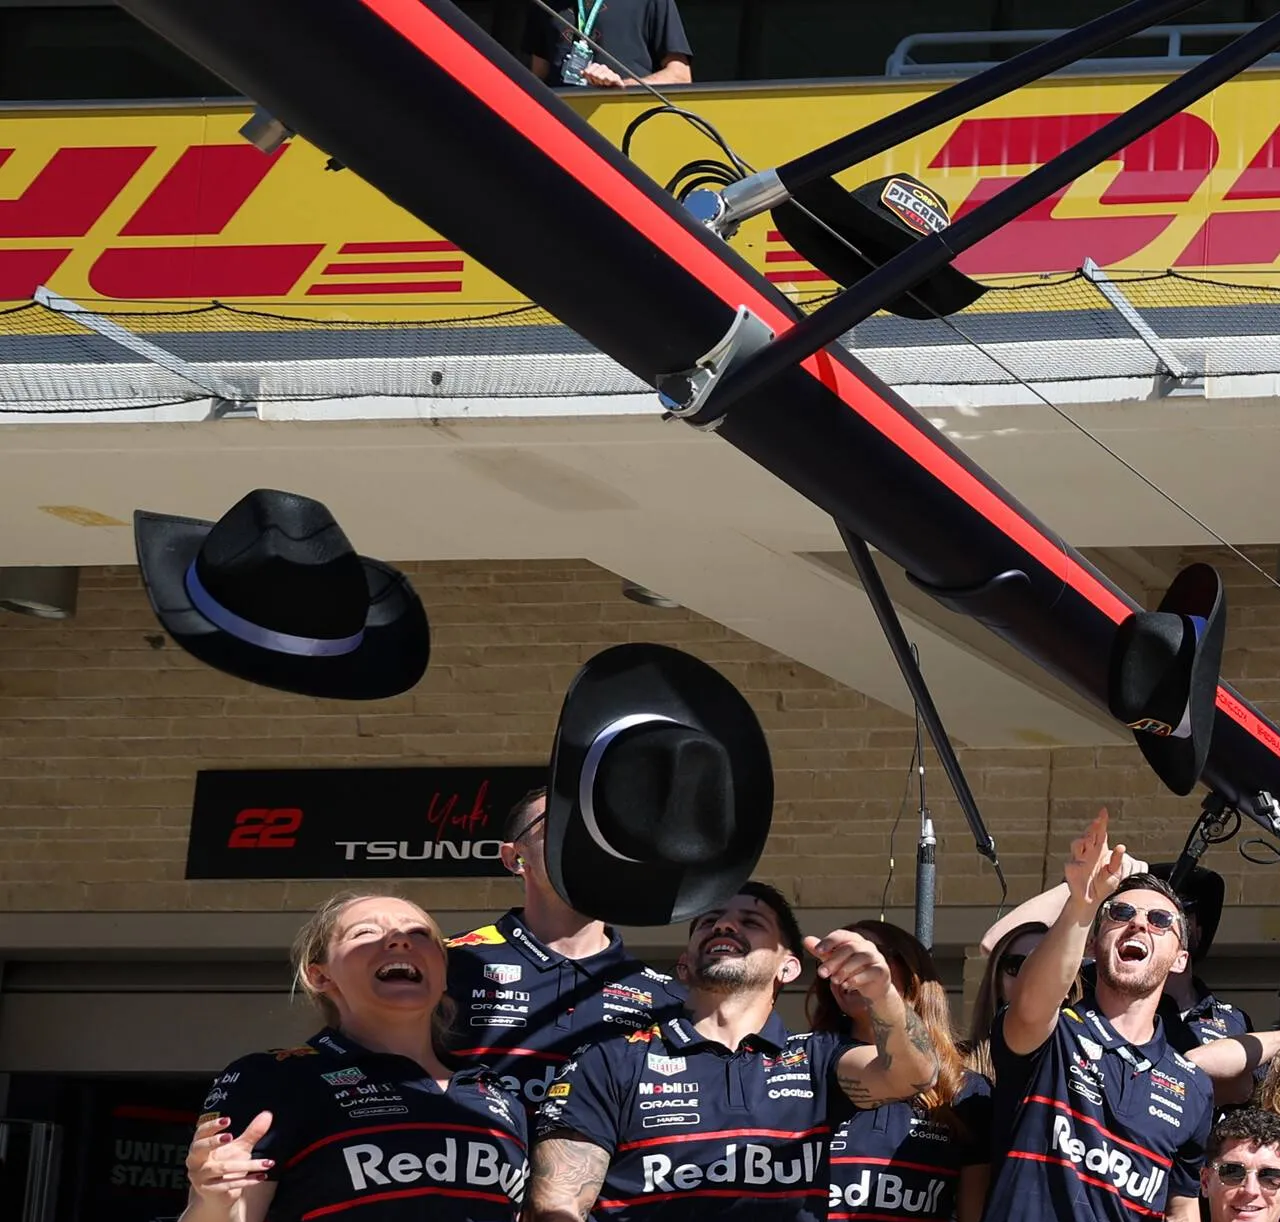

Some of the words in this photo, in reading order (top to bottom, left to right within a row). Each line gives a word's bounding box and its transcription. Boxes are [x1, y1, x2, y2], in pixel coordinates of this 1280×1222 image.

[889, 186, 914, 207] PIT
[911, 200, 948, 233] CREW
[427, 780, 493, 840] Yuki
[228, 808, 304, 849] 22
[335, 840, 502, 861] TSUNO
[471, 989, 513, 1000] Mobil
[603, 981, 652, 997] ORACLE
[471, 1003, 529, 1014] ORACLE
[499, 1065, 556, 1103] ed
[638, 1082, 682, 1095] Mobil
[766, 1073, 811, 1085] HONDA
[1151, 1068, 1185, 1088] ORACLE
[639, 1099, 698, 1110] ORACLE
[656, 1115, 685, 1124] MARIO
[114, 1138, 187, 1165] UNITE
[1052, 1114, 1109, 1175] Red
[1108, 1149, 1166, 1204] Bull
[109, 1164, 190, 1190] STATE
[342, 1138, 456, 1191] Red
[466, 1141, 530, 1203] Bull
[642, 1143, 736, 1194] Red
[743, 1141, 823, 1185] Bull
[828, 1169, 871, 1208] ed
[875, 1173, 946, 1214] Bull
